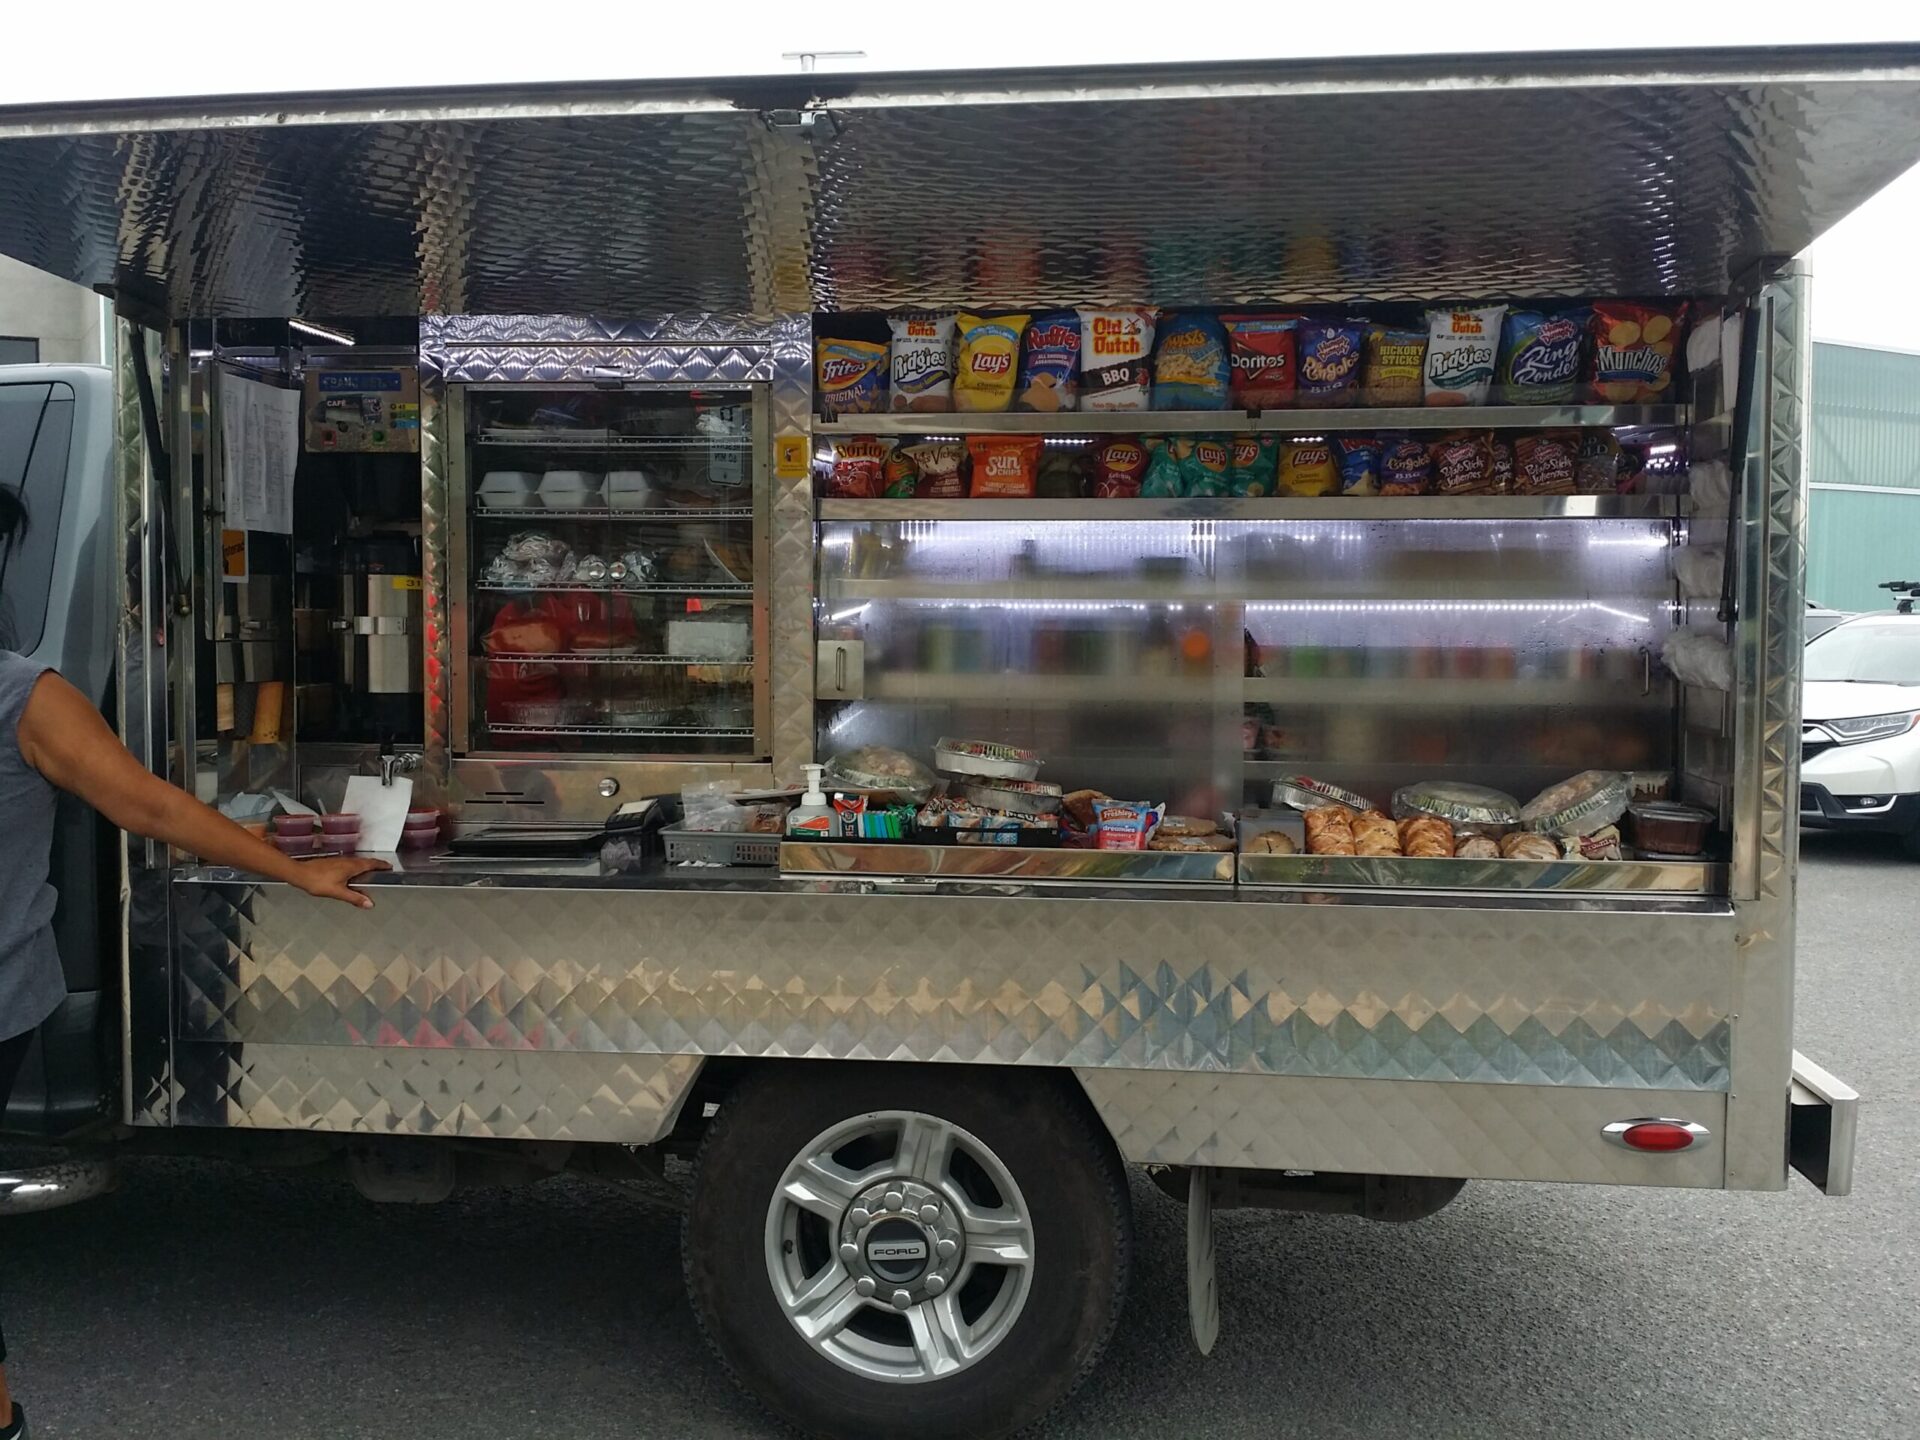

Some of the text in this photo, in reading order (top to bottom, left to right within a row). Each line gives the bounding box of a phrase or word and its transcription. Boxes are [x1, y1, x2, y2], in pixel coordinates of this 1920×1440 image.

[908, 325, 936, 337] Dutch
[1094, 316, 1121, 335] Old
[1452, 321, 1482, 334] Dutch
[1028, 325, 1082, 351] Ruffles
[1093, 335, 1141, 354] Dutch
[1380, 345, 1424, 355] HICKORY
[893, 347, 947, 383] Ridgies
[973, 353, 1010, 373] Lay's
[1230, 353, 1285, 368] Doritos
[1382, 355, 1420, 365] STICKS
[1429, 344, 1492, 379] Ridgies
[1598, 346, 1668, 375] Munchos
[823, 359, 866, 382] Fritos
[1102, 368, 1129, 386] BBQ
[825, 384, 866, 403] ORIGINAL
[986, 455, 1022, 476] Sun
[1105, 450, 1138, 464] Lay's
[1294, 450, 1328, 465] Lay's
[998, 466, 1021, 475] CHIPS
[874, 1248, 920, 1256] FORD
